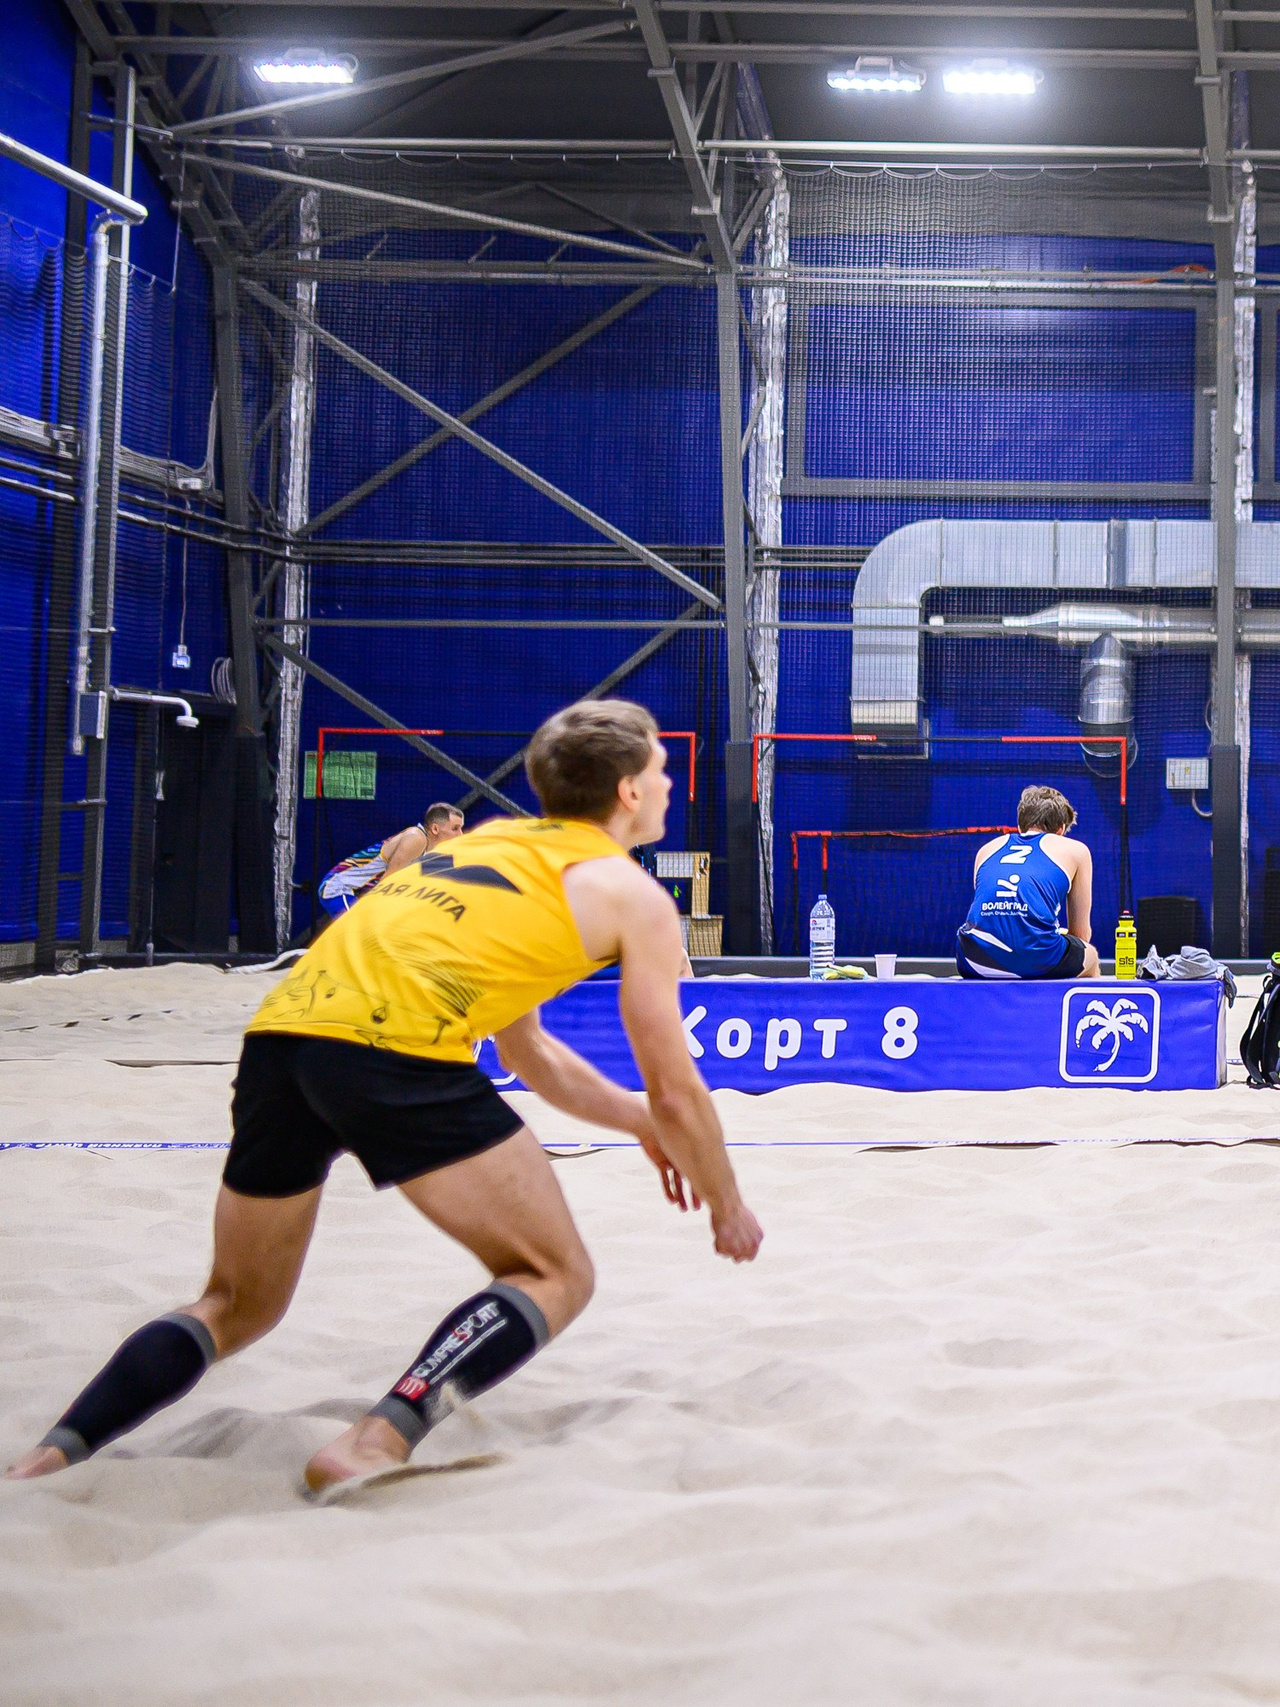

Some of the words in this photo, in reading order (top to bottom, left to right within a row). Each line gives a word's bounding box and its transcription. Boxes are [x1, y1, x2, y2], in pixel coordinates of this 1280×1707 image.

[406, 886, 466, 922] ЛИГА
[981, 900, 1028, 912] ВОЛЕЙГРАД
[881, 1006, 919, 1059] 8
